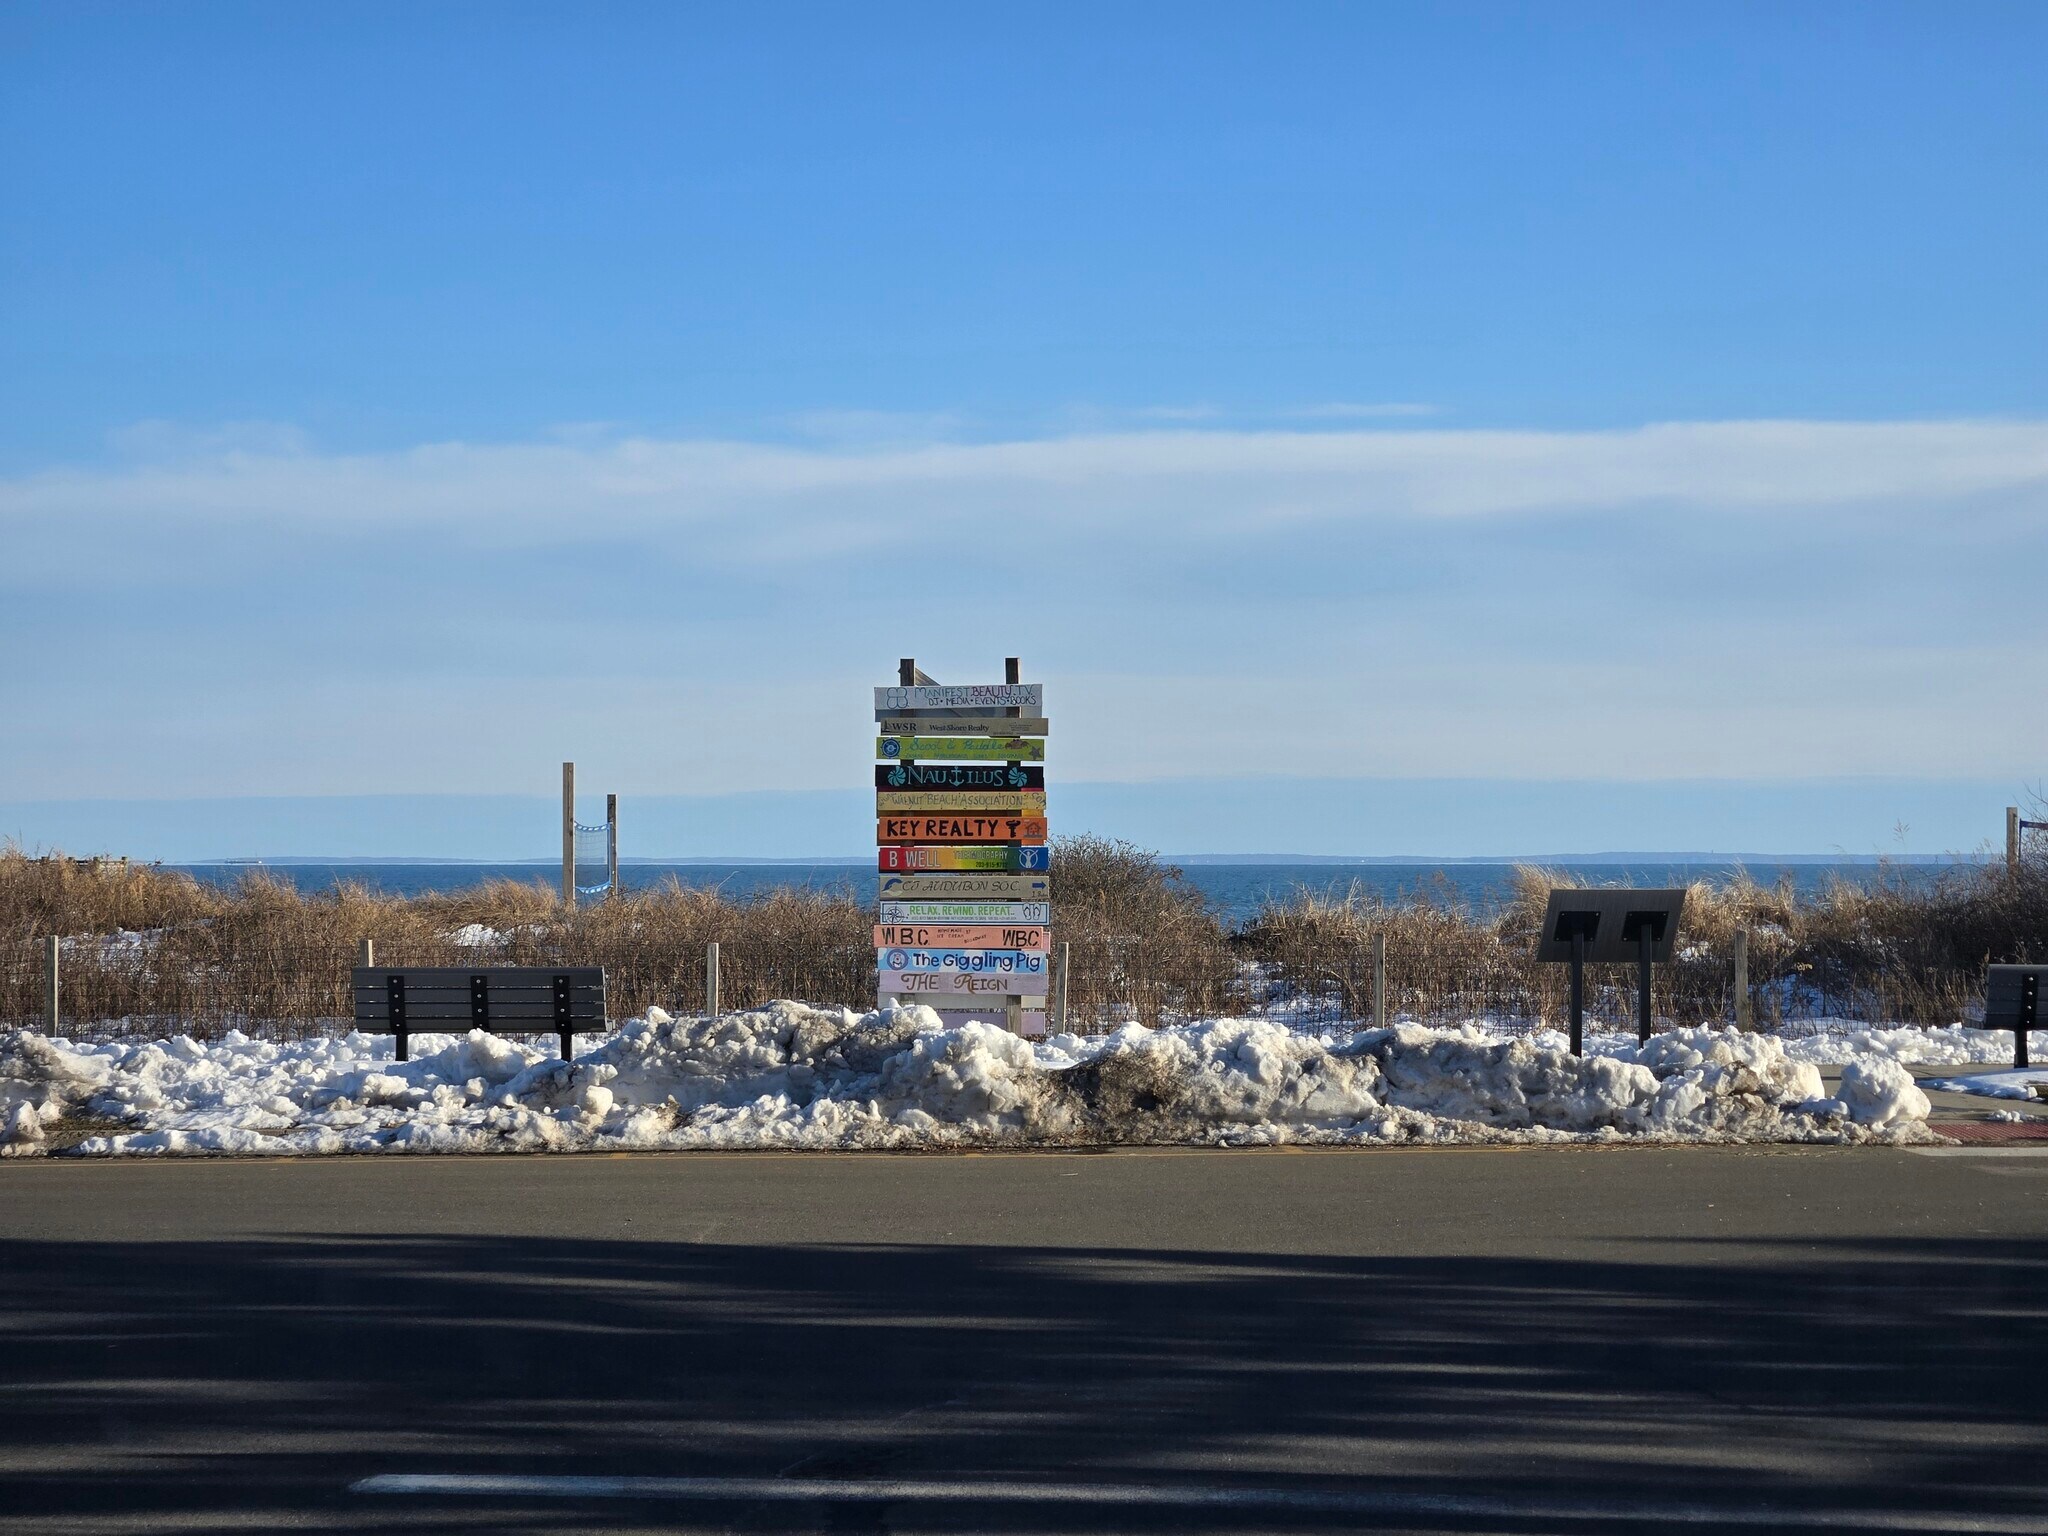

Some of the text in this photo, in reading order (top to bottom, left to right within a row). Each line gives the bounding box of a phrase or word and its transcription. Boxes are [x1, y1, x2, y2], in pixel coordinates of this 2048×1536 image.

[946, 697, 969, 705] MEDIA
[975, 697, 1006, 705] EVENTS
[1010, 696, 1036, 705] BOOKS
[892, 723, 917, 731] WSR
[968, 724, 989, 733] Realty
[927, 794, 958, 805] BEACH
[959, 794, 1023, 805] ASSOCIATION
[887, 819, 998, 837] KEY REALTY
[889, 851, 940, 868] B WELL
[921, 881, 988, 892] AUDUBON
[909, 905, 940, 915] RELAX.
[942, 905, 976, 916] REWIND.
[913, 952, 1041, 972] The Giggling Pig
[900, 972, 1008, 994] THE REIGN
